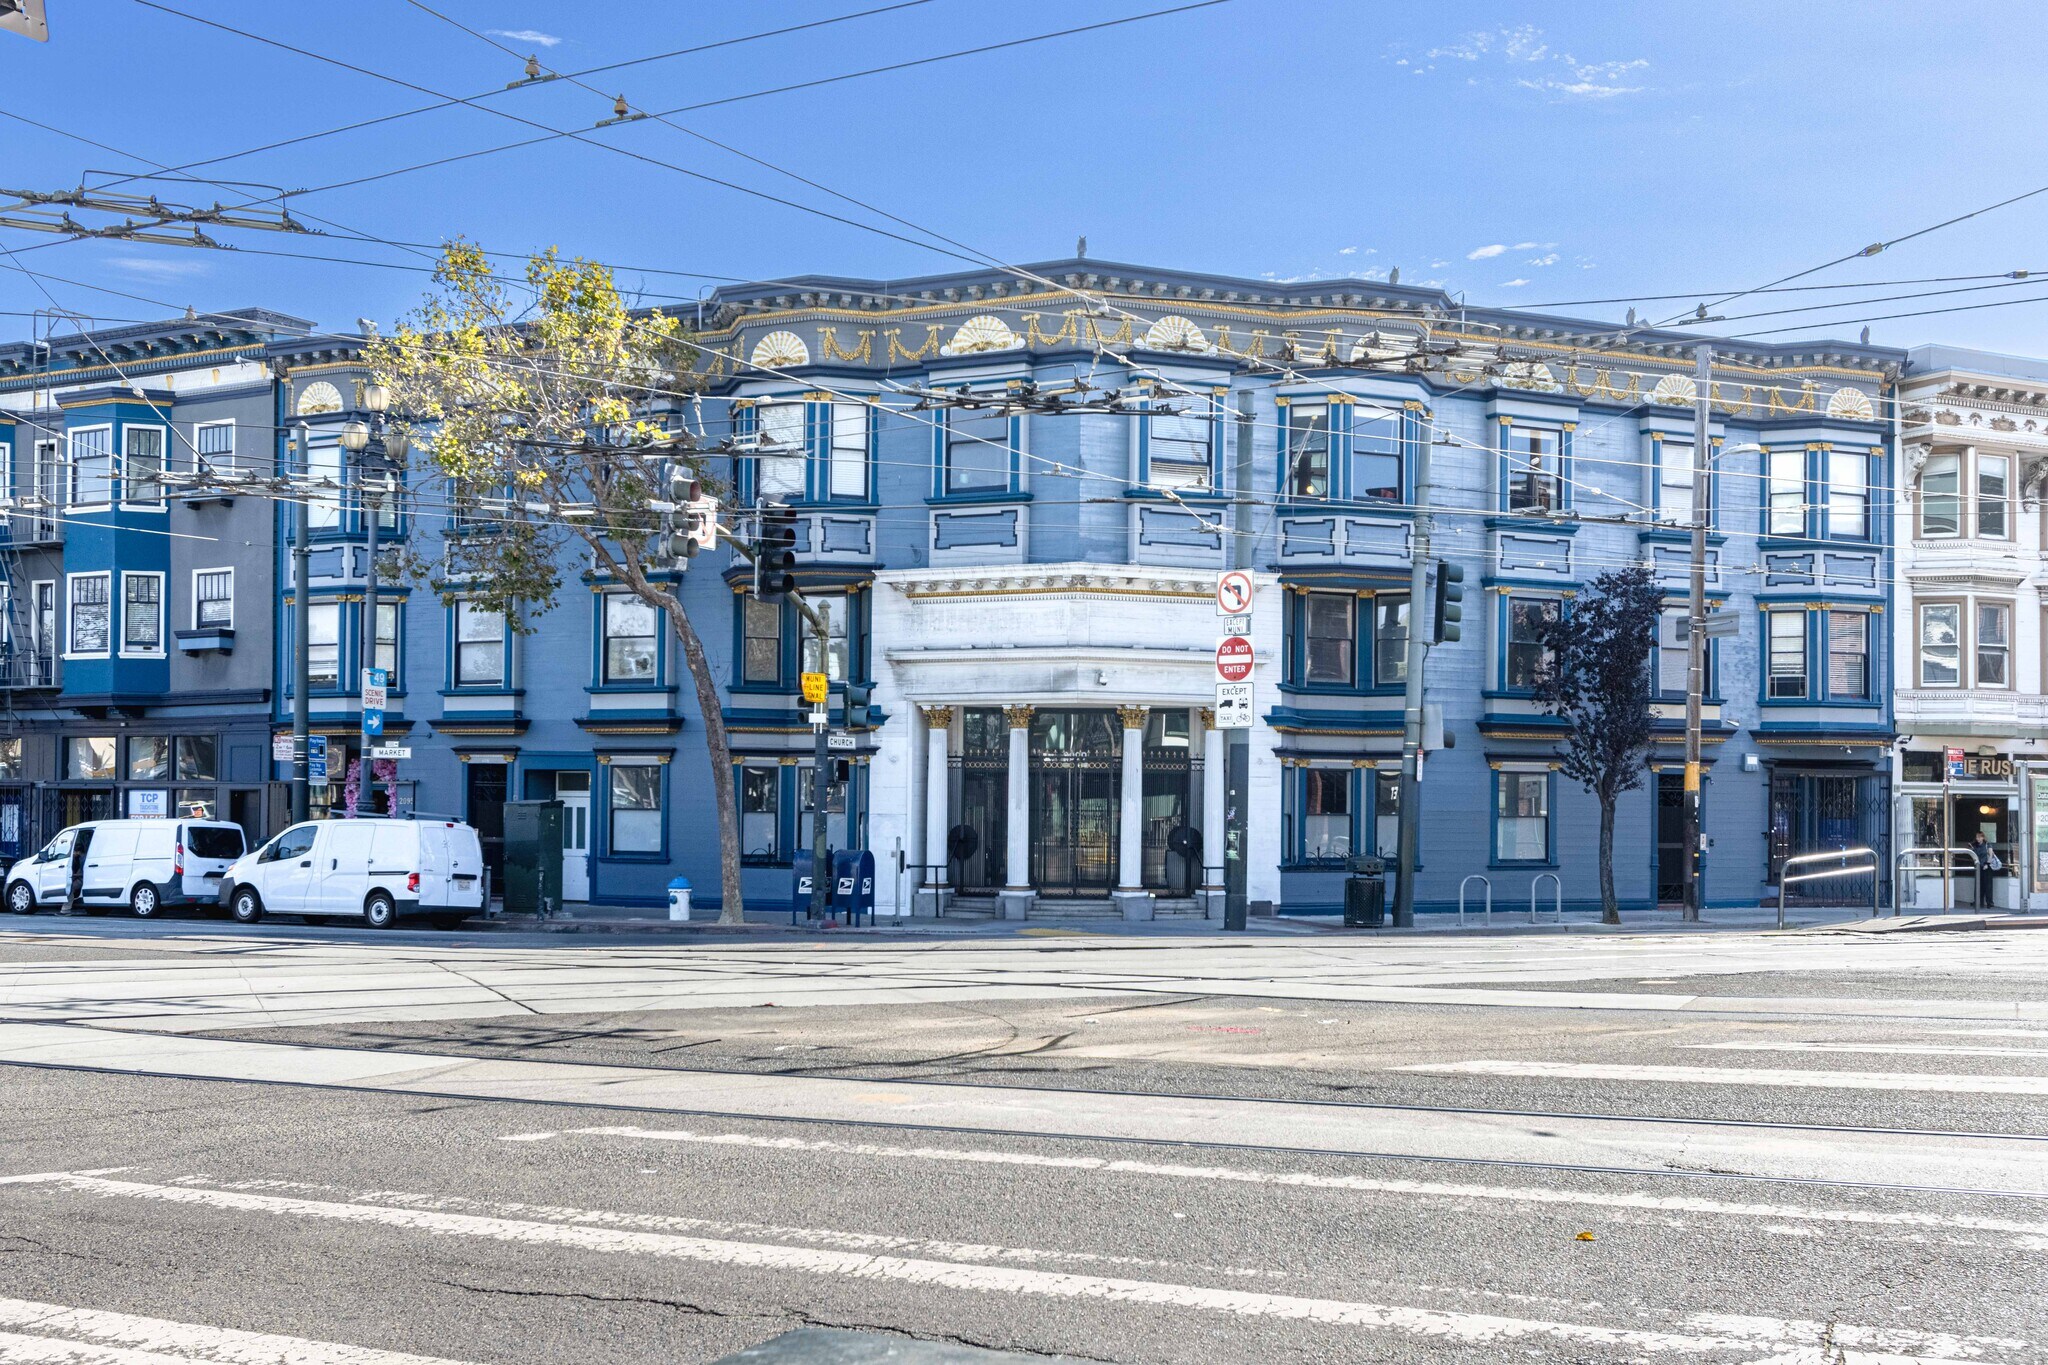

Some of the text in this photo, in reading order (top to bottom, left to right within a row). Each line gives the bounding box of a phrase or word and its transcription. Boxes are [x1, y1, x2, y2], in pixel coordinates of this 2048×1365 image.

[1226, 618, 1244, 626] EXCEPT
[1222, 645, 1248, 654] DO NOT
[1224, 665, 1246, 673] ENTER
[374, 673, 385, 683] 49
[365, 689, 383, 697] SCENIC
[1222, 687, 1247, 696] EXCEPT
[830, 738, 853, 746] CHURCH
[140, 793, 158, 803] TCP
